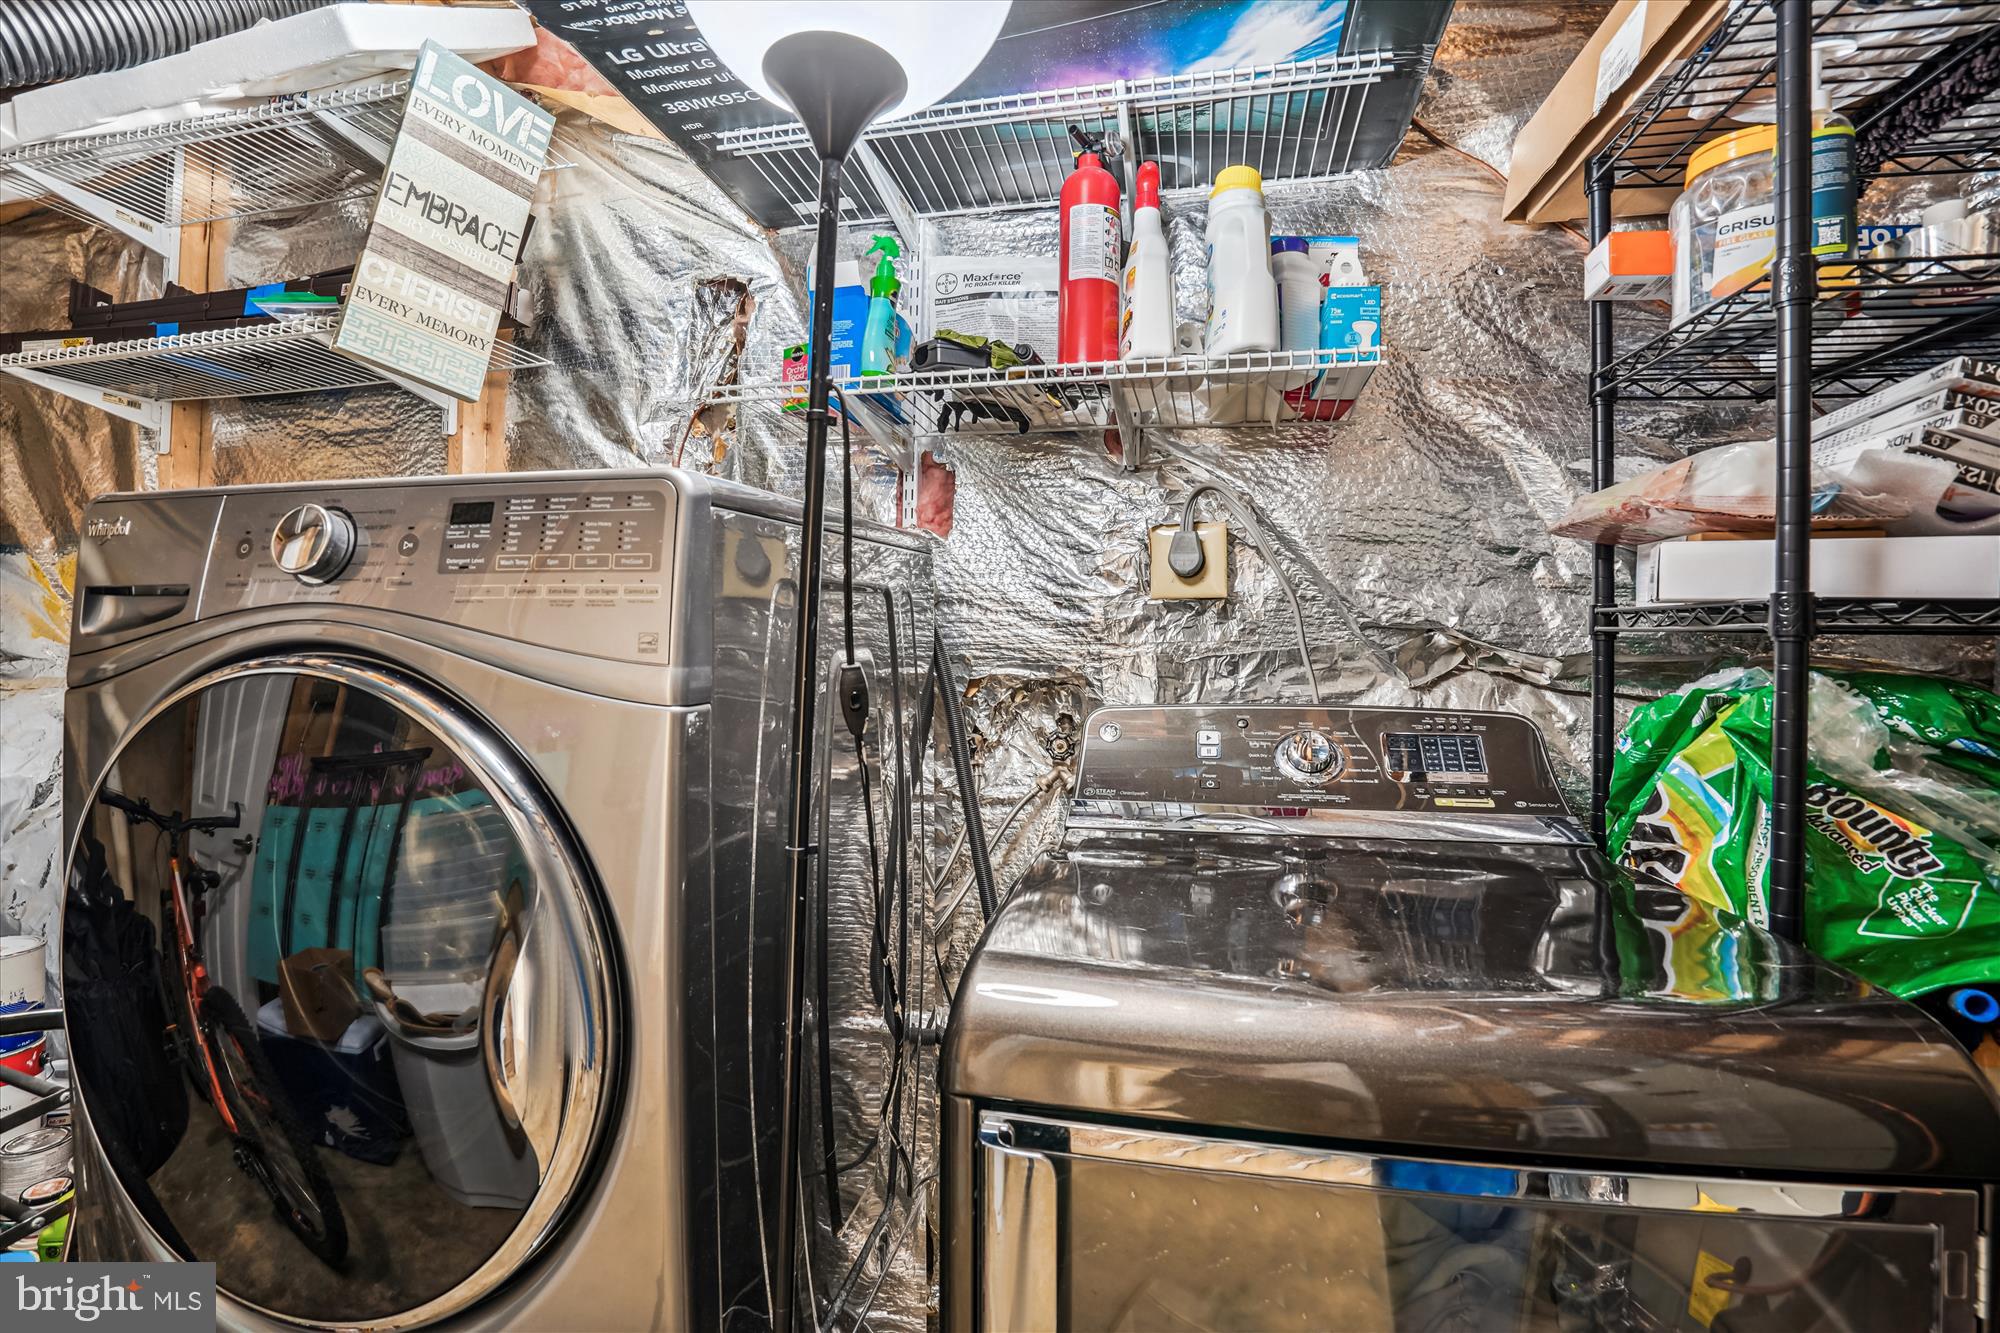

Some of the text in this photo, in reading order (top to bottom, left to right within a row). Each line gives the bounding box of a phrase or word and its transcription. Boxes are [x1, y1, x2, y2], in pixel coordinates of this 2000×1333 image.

[560, 3, 582, 12] LG
[605, 1, 645, 13] Curvo
[605, 7, 675, 27] Monitor
[570, 18, 603, 29] Curved
[606, 48, 645, 65] LG
[625, 58, 717, 81] Monitor LG
[641, 73, 735, 95] Moniteur Ul
[416, 50, 556, 157] LOVE
[661, 90, 761, 114] 38WK95C
[412, 97, 540, 177] EVERY MOMENT
[681, 122, 704, 131] HDR
[692, 132, 713, 141] USB
[384, 171, 519, 262] EMBRACE
[381, 205, 512, 276] EVERY POSSIBILITY
[361, 256, 498, 332] CHERISH
[355, 285, 491, 352] EVERY MEMORY
[786, 366, 808, 376] Orchid
[788, 373, 805, 381] Food
[1885, 432, 1913, 451] HDX
[1806, 813, 1883, 874] Advanced
[1919, 881, 1939, 902] The
[1895, 892, 1929, 924] Picker
[1909, 887, 1949, 926] Quicker
